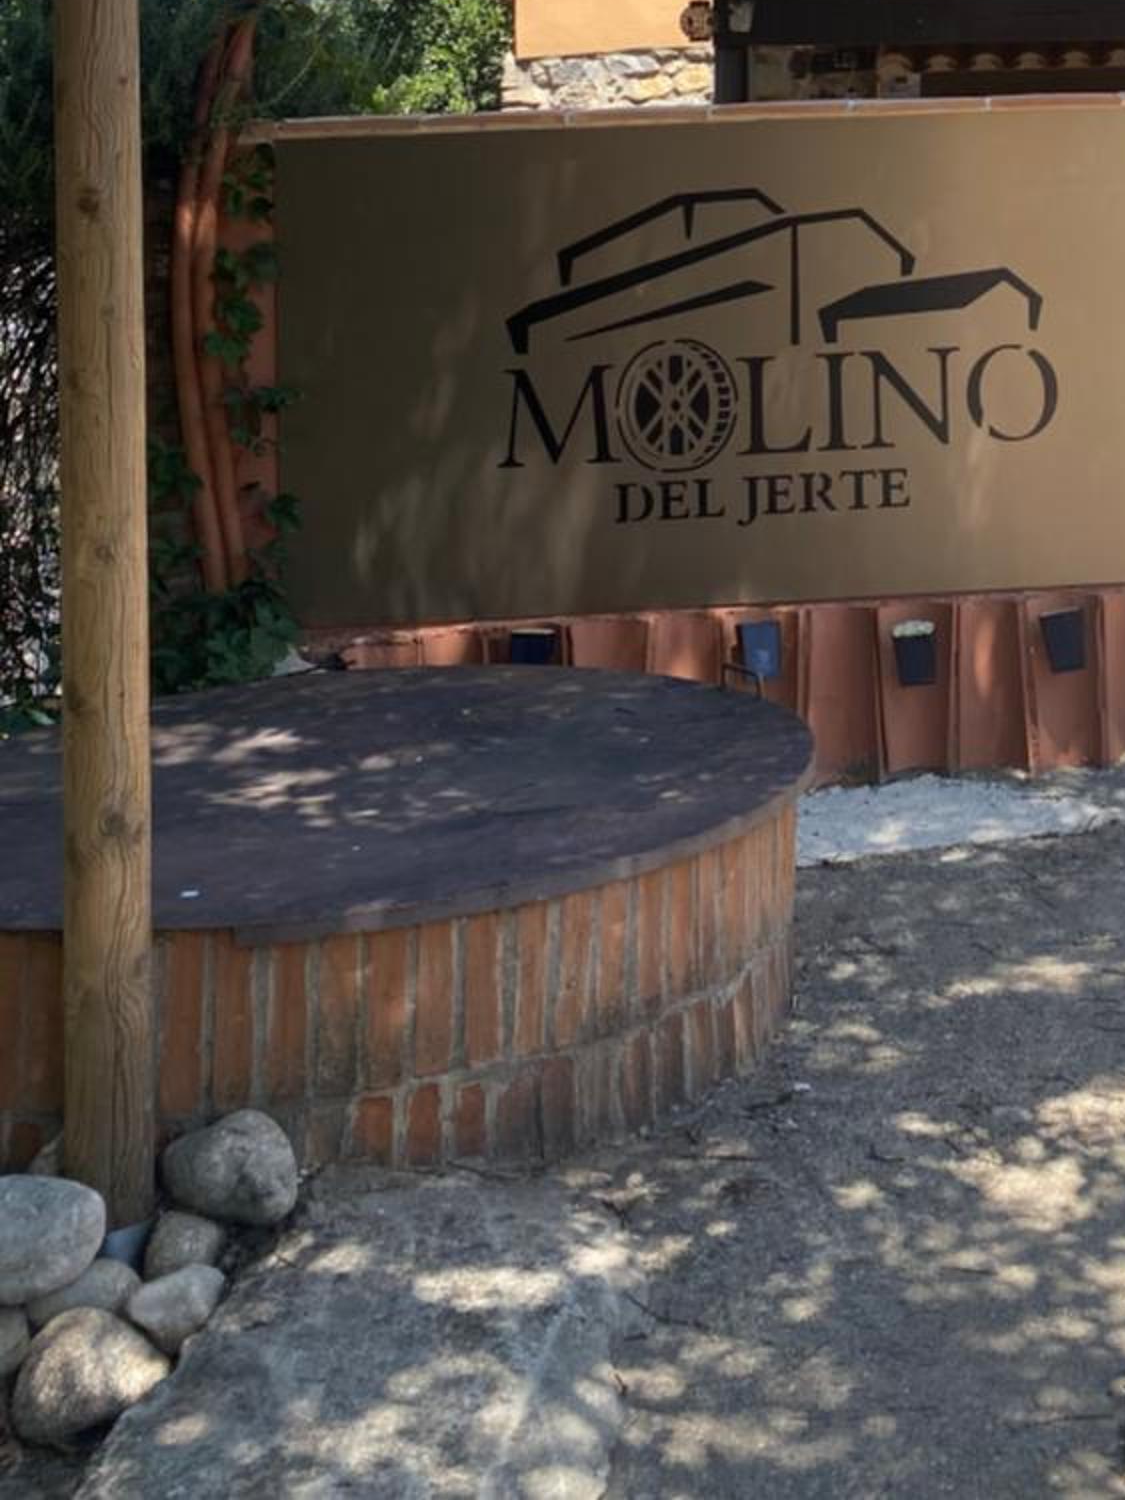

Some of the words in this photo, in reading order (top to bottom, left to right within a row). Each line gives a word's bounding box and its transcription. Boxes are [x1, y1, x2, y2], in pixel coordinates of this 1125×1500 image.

[497, 339, 1059, 472] MOLINO
[613, 478, 725, 524] DEL
[737, 468, 911, 527] JERTE
